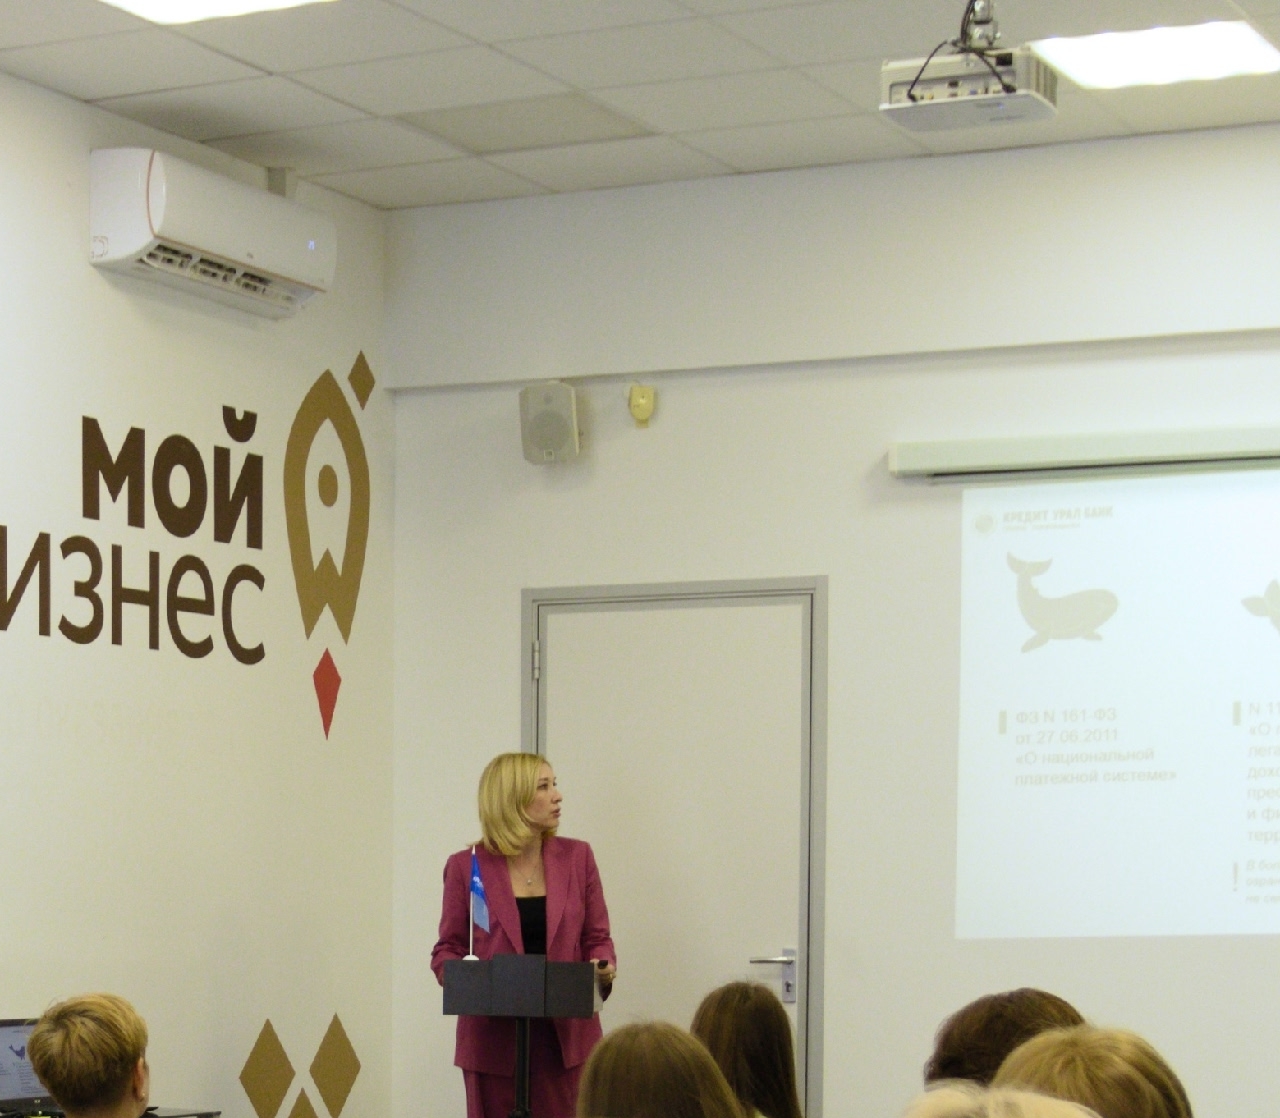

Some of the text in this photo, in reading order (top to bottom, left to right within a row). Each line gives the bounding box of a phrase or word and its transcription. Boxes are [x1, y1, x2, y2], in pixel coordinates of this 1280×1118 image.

[81, 404, 264, 551] мой
[1016, 710, 1039, 724] ФЗ
[1042, 748, 1154, 766] национальной
[1015, 770, 1099, 786] платежной
